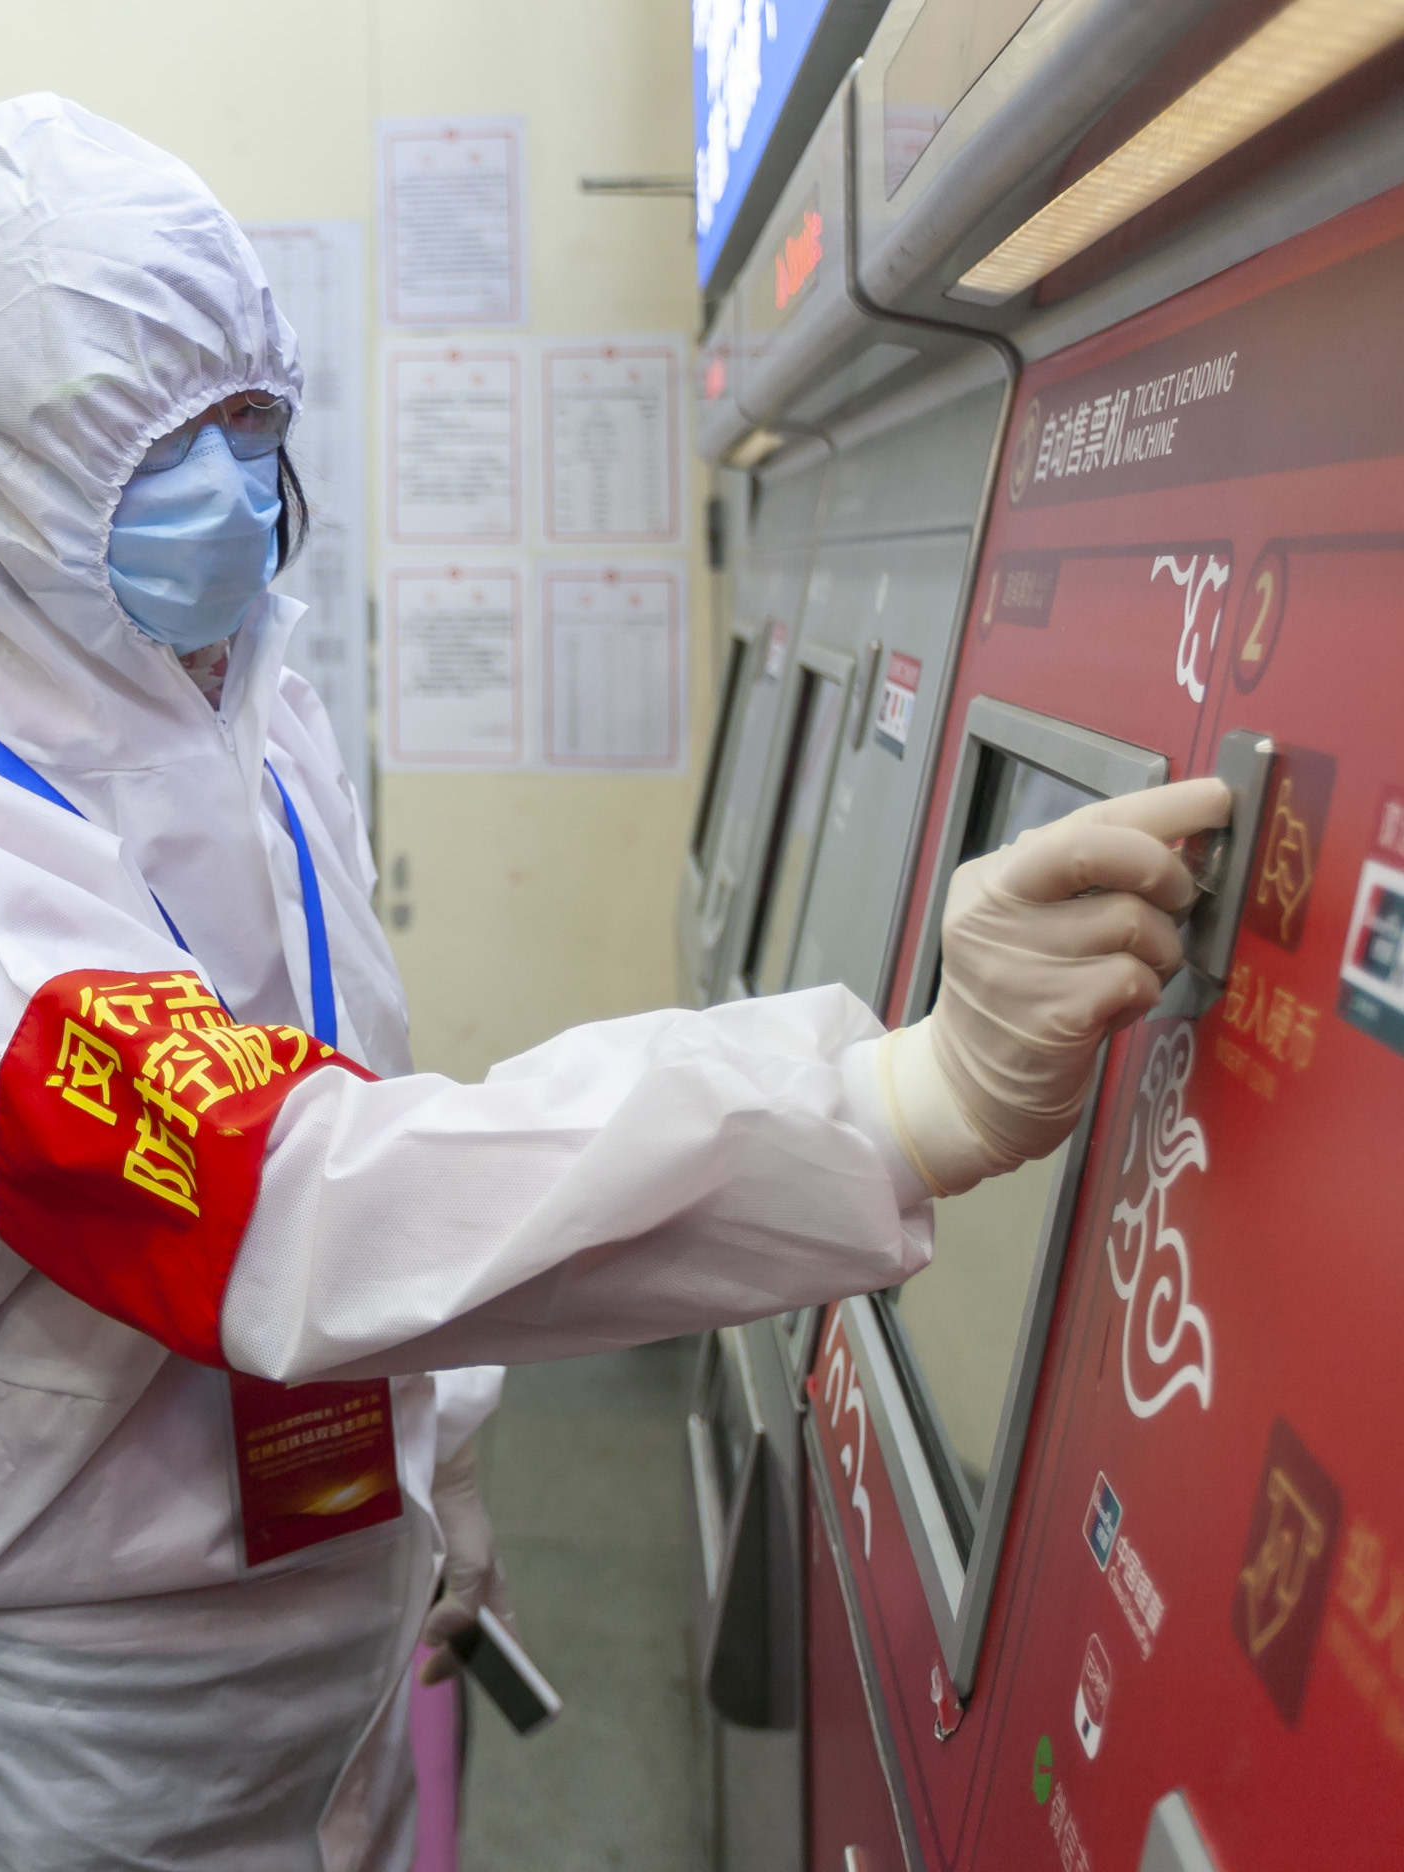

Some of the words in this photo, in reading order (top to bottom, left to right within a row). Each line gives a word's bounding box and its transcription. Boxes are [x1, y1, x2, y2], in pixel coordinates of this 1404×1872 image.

[1132, 374, 1176, 419] TICKET
[1174, 351, 1238, 407] VENDING
[1033, 388, 1131, 484] 自动售票机
[1122, 417, 1179, 464] MACHINE
[1240, 570, 1275, 662] 2
